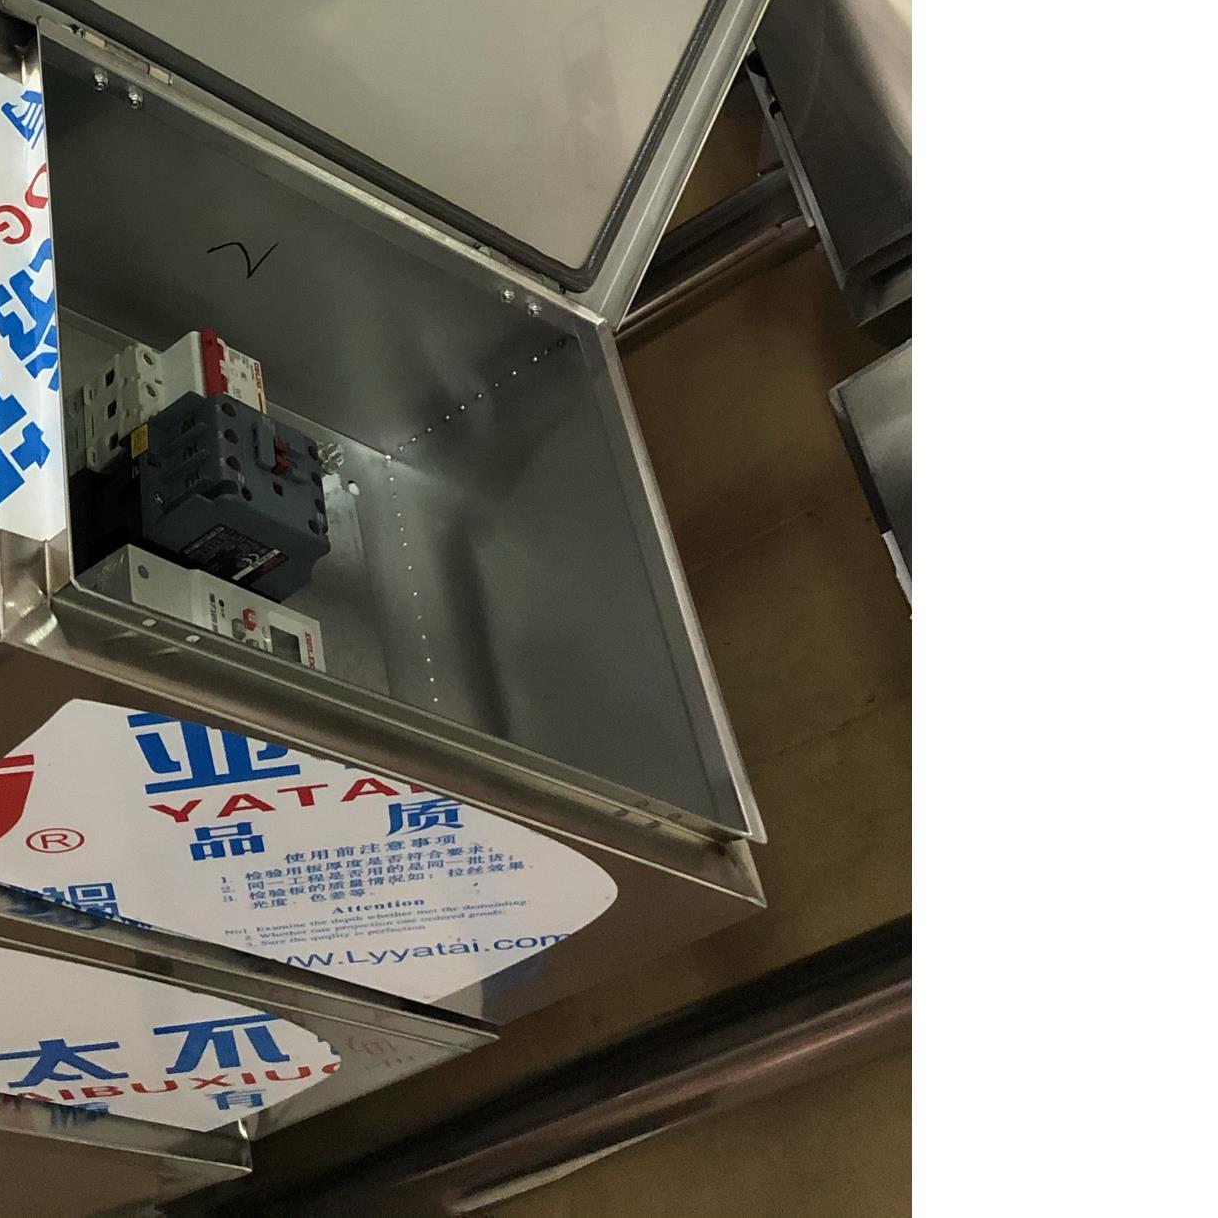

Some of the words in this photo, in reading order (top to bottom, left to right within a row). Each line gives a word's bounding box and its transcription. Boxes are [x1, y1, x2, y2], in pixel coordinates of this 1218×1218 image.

[189, 824, 267, 862] 品
[384, 798, 465, 839] 质
[283, 832, 458, 866] 使用前注意事项
[331, 896, 426, 916] Attention
